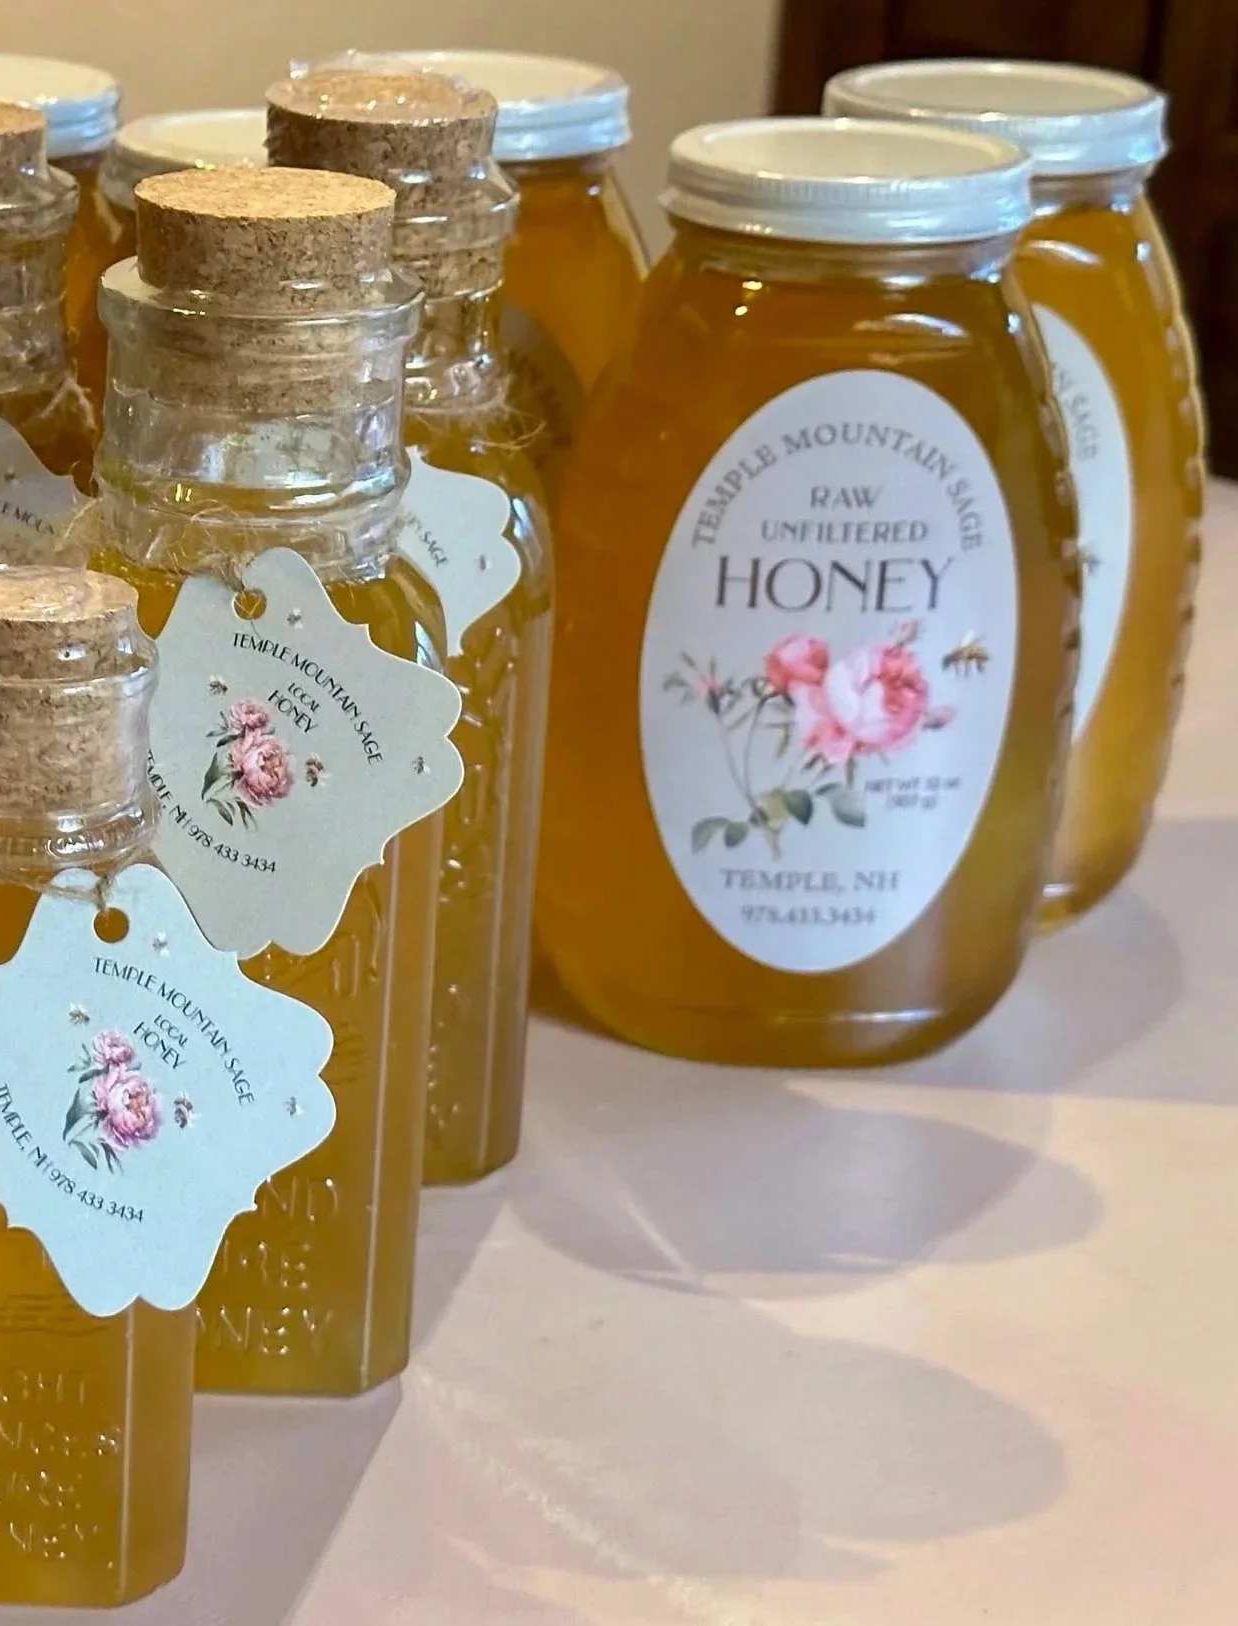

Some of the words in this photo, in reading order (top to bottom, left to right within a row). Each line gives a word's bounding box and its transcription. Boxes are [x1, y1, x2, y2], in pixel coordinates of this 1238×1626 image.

[692, 444, 778, 549] TEMPLE
[781, 421, 955, 480] MOUNTAIN
[946, 478, 983, 551] SAGE
[810, 485, 881, 509] RAW
[762, 520, 929, 544] UNFILTERED
[716, 555, 953, 613] HONEY
[233, 632, 292, 663] TEMPLE
[290, 653, 363, 722] MOUNTAIN
[353, 720, 384, 766] SAGE
[267, 689, 319, 734] HONEY
[287, 682, 321, 713] LOCAL
[169, 804, 192, 830] NH
[189, 824, 213, 848] 978
[213, 843, 239, 863] 433
[241, 854, 277, 874] 3434
[720, 867, 846, 896] TEMPLE,
[853, 868, 902, 892] NH
[95, 957, 157, 991] TEMPLE
[158, 981, 233, 1057] MOUNTAIN
[224, 1057, 255, 1105] SAGE
[133, 1021, 186, 1070] HONEY
[153, 1014, 189, 1050] LOCAL
[27, 1145, 55, 1175] NH
[49, 1168, 76, 1195] 978
[77, 1190, 104, 1211] 433
[106, 1202, 144, 1223] 3434
[195, 1305, 334, 1354] NEY
